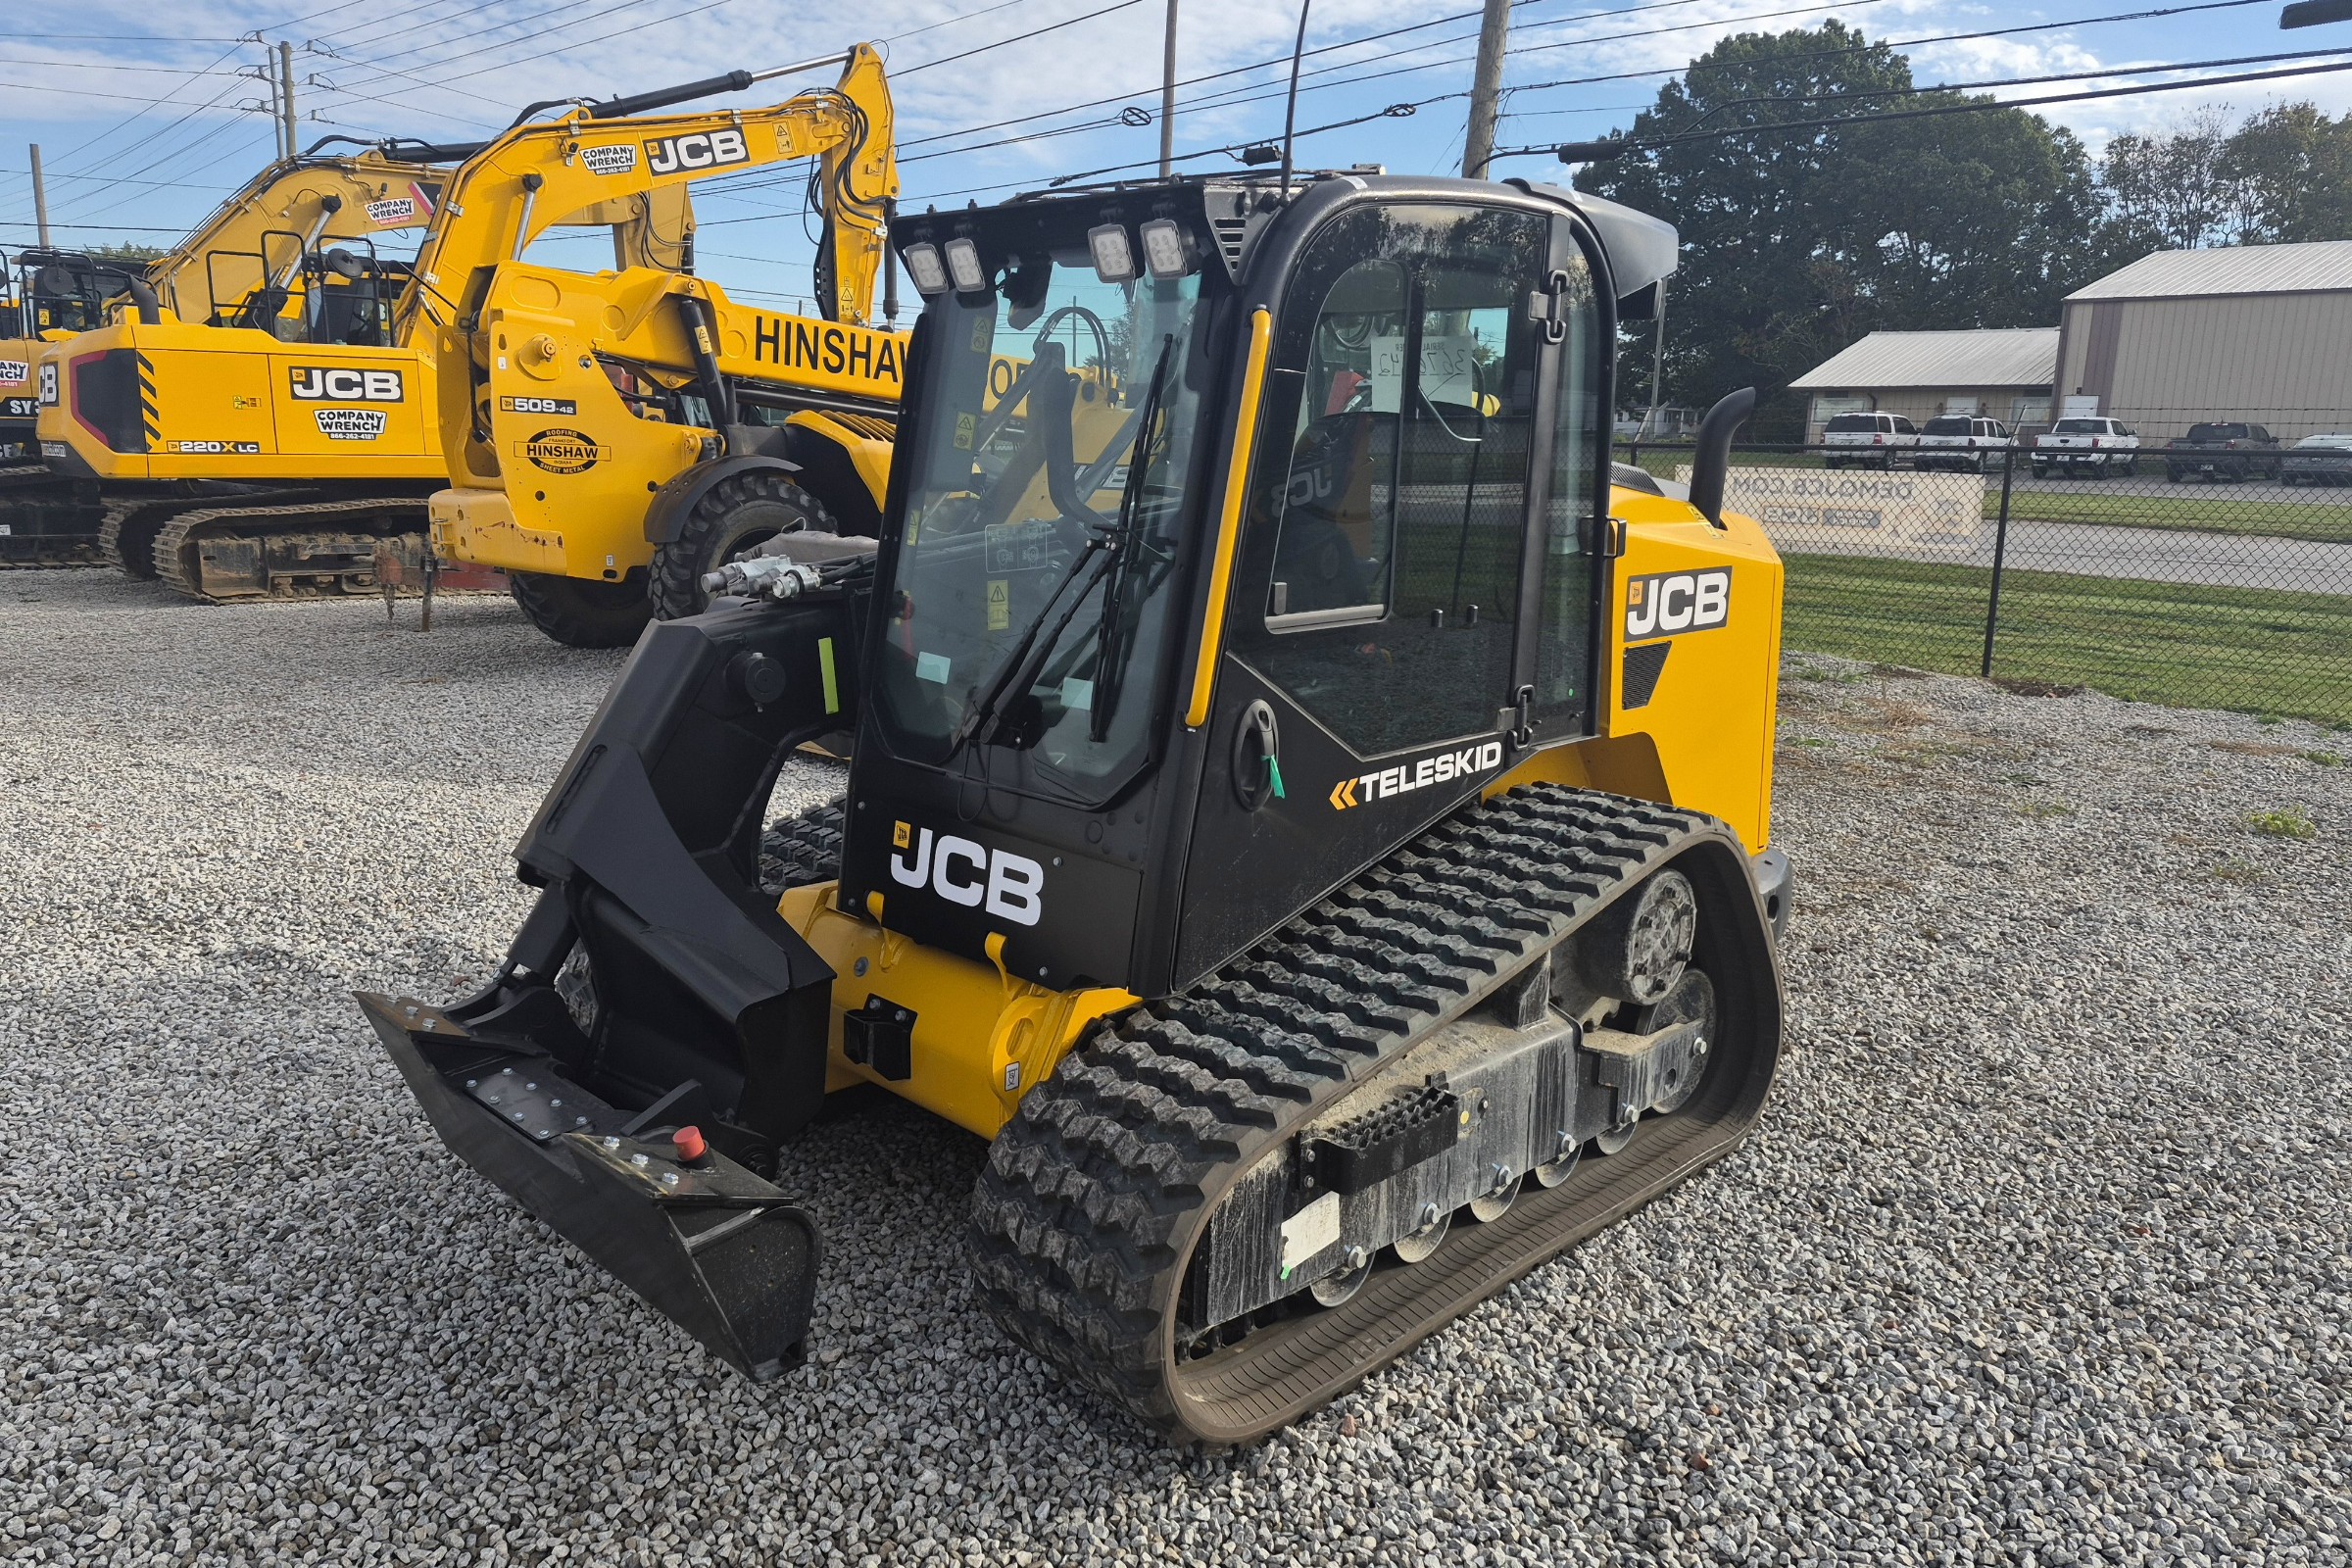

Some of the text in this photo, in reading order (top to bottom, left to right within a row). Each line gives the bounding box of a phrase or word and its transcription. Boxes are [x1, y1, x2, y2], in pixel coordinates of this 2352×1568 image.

[582, 146, 634, 160] COMPANY
[651, 130, 747, 172] JCB
[586, 154, 633, 168] WRENCH
[367, 199, 413, 213] COMPANY
[370, 207, 412, 220] WRENCH
[756, 316, 906, 383] HINSHA
[38, 366, 57, 403] CB
[292, 369, 401, 400] JCB
[10, 400, 31, 415] SY
[318, 411, 383, 422] COMPANY
[320, 420, 381, 431] WRENCH
[546, 429, 578, 438] ROOFING
[179, 441, 236, 453] 220X
[238, 444, 259, 453] LC
[526, 444, 599, 459] HINSHAW
[540, 463, 561, 473] SHEET
[1627, 572, 1728, 635] JCB
[1359, 741, 1501, 802] TELESKID
[890, 827, 1044, 926] JCB
